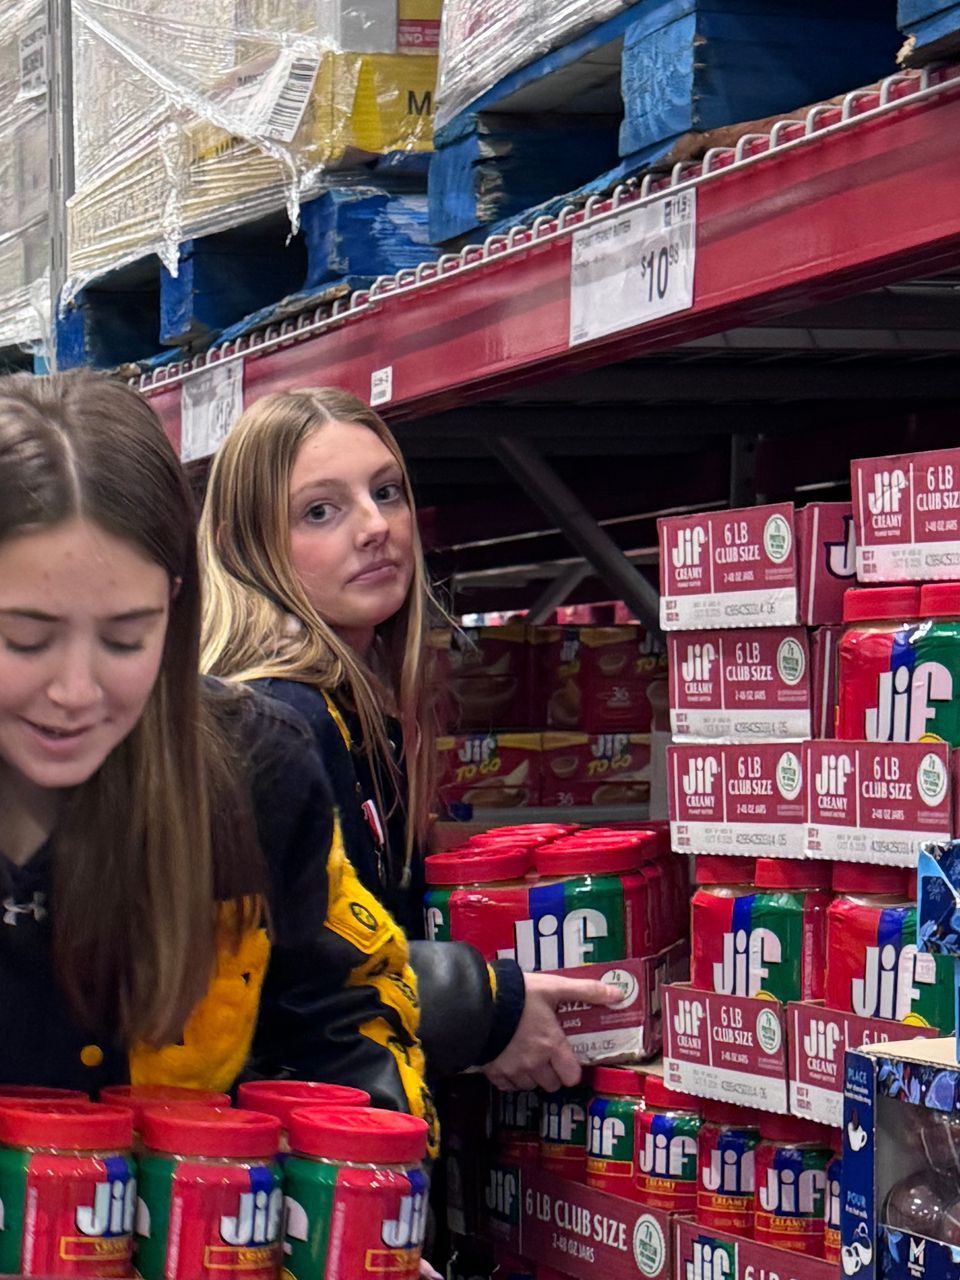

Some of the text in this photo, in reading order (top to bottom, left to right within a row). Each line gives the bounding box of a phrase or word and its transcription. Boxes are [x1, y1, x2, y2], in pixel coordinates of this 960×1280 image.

[869, 470, 906, 513] Jif
[672, 526, 705, 568] Jif
[682, 642, 715, 681] Jif
[865, 661, 952, 741] Jif
[682, 756, 718, 795] Jif
[815, 754, 851, 795] Jif
[497, 908, 608, 972] Jif
[713, 928, 781, 998] Jif
[851, 944, 936, 1020] Jif
[674, 1000, 703, 1037] Jif
[803, 1020, 840, 1061] Jif
[847, 1068, 868, 1084] PLACE
[639, 1133, 697, 1176] Jif
[759, 1168, 827, 1212] Jif
[554, 1199, 628, 1252] CLUB SIZE
